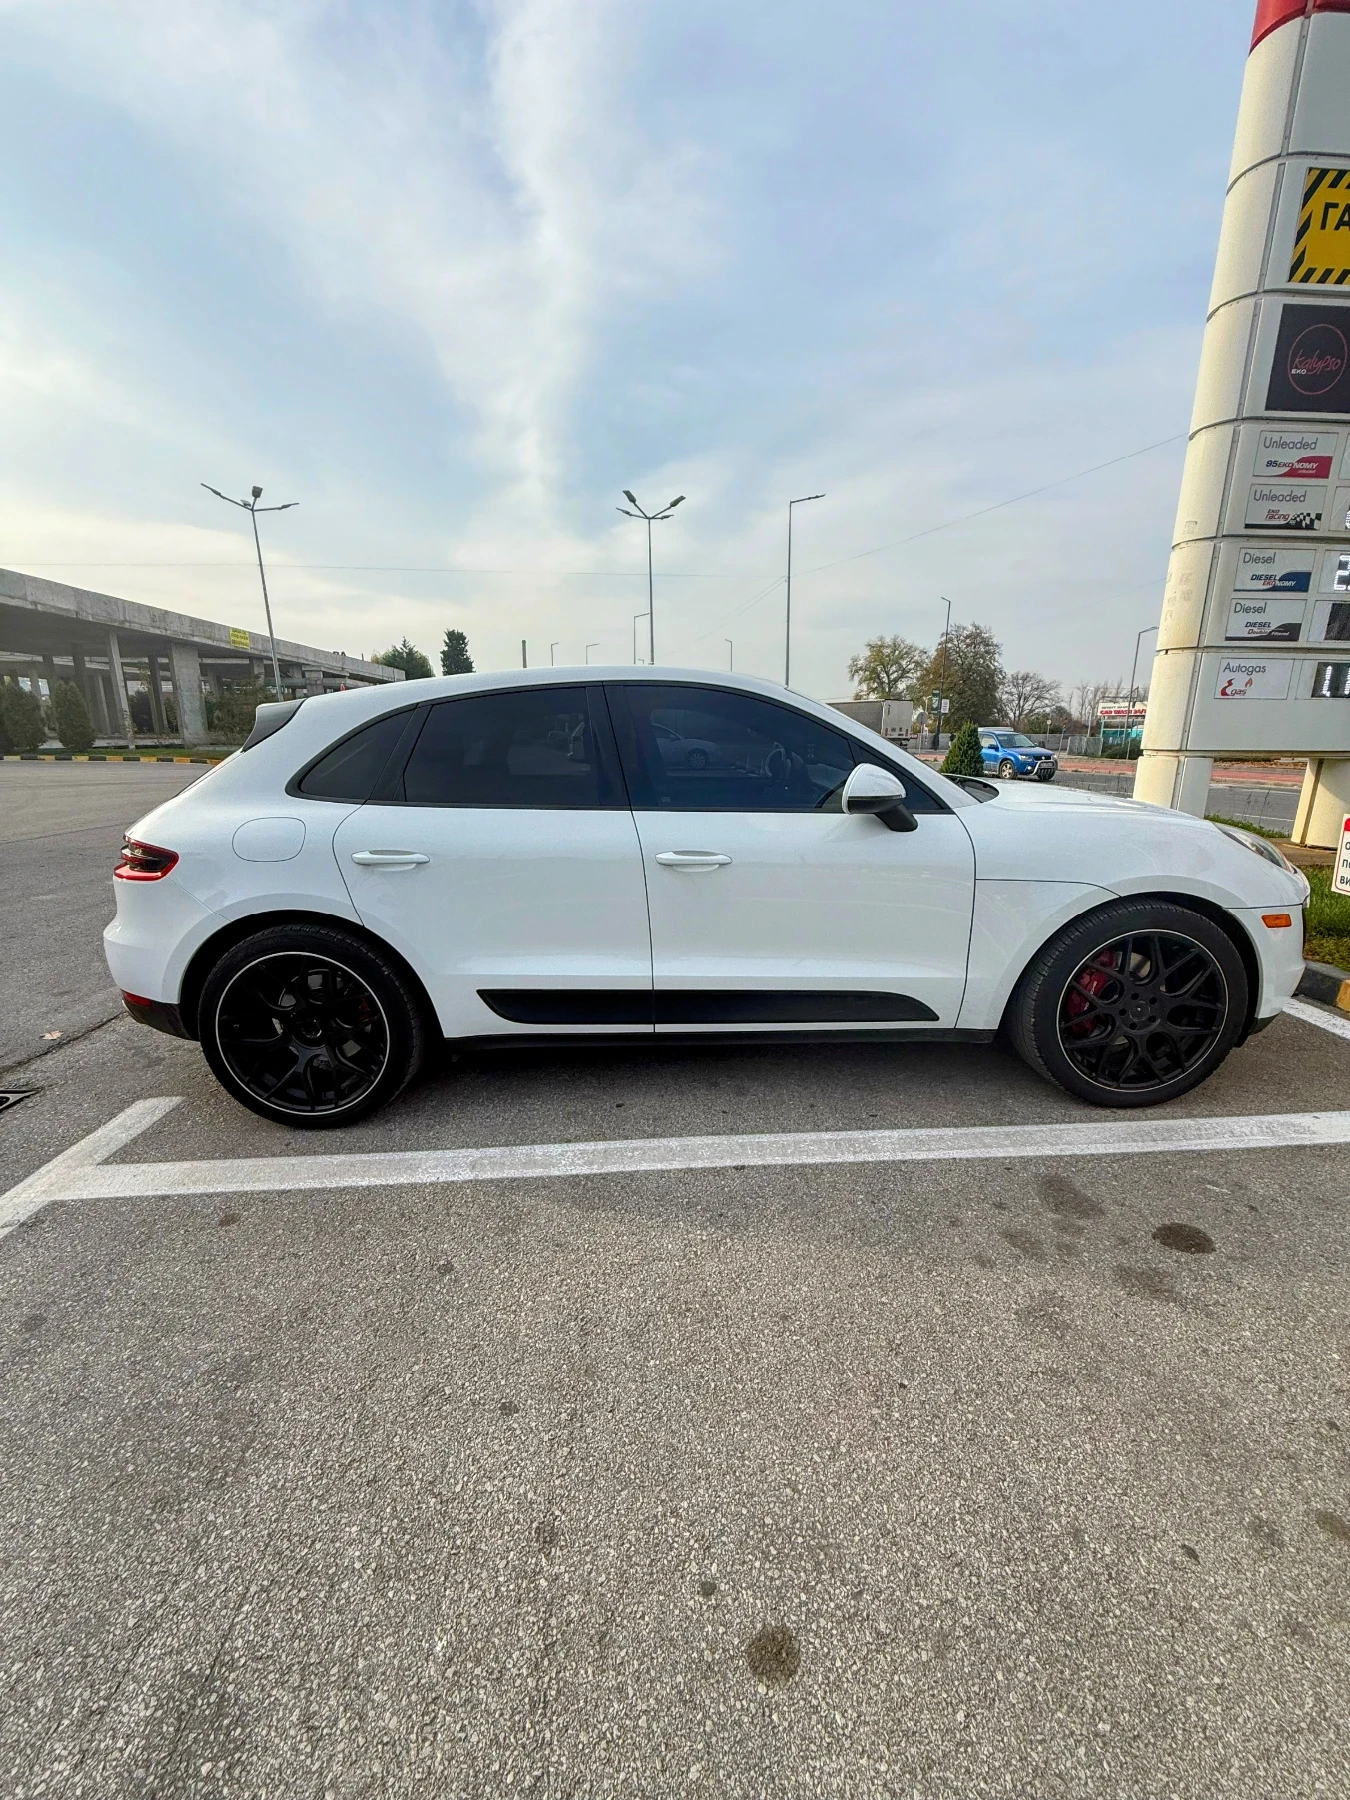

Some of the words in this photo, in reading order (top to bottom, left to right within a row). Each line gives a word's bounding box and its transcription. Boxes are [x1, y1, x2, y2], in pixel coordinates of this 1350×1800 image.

[1263, 436, 1319, 450] Unleaded
[1253, 490, 1307, 502] Unleaded
[1265, 513, 1290, 521] racing
[1243, 552, 1277, 564] Diesel
[1233, 602, 1268, 614] Diesel
[1222, 661, 1267, 676] Autogas
